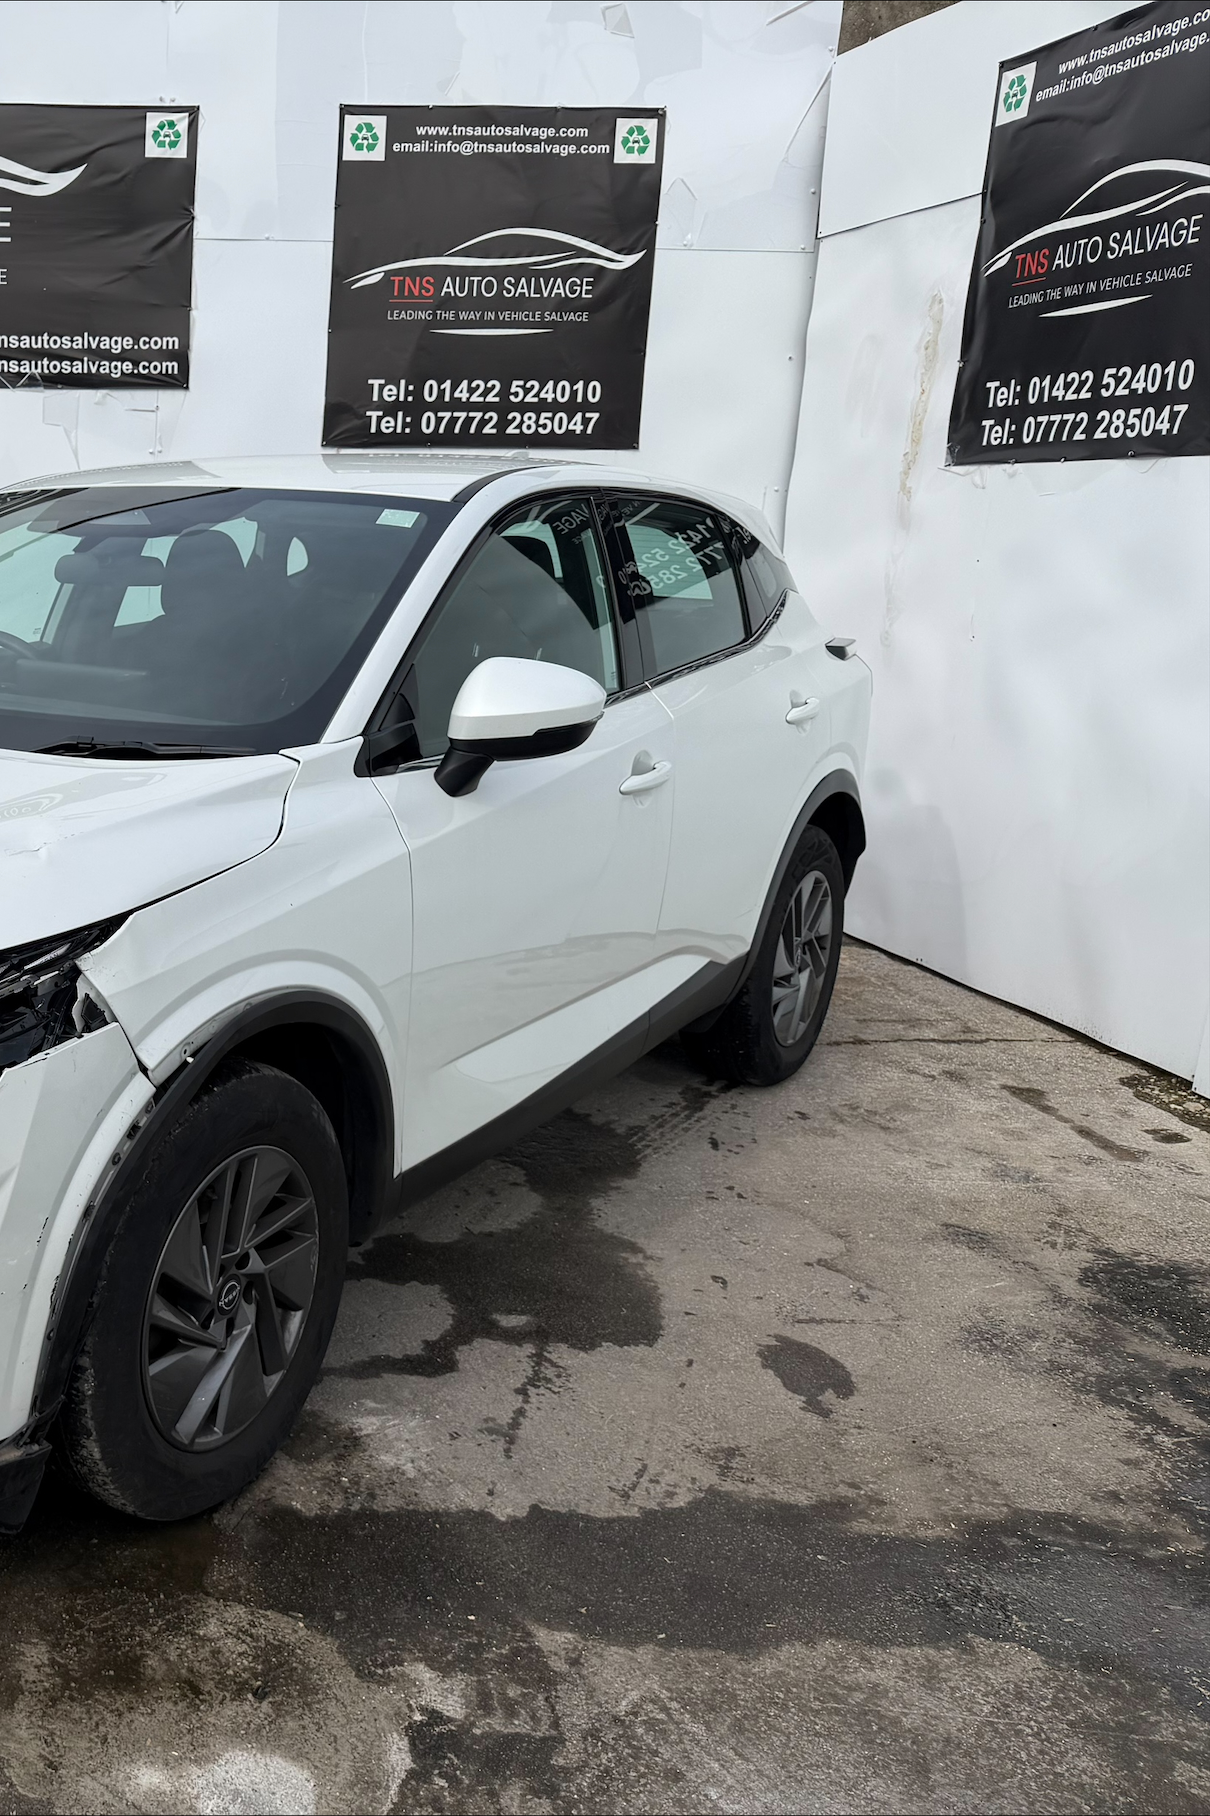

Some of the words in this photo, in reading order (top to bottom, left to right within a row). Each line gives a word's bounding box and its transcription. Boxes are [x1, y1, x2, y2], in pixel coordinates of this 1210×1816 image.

[416, 124, 588, 139] www.tnsautosalvage.com
[393, 141, 610, 156] email:info@tnsautosalvage.com
[1015, 249, 1050, 279] TNS
[1053, 234, 1103, 271] AUTO
[1107, 214, 1204, 260] SALVAGE
[390, 276, 435, 296] TNS
[441, 276, 497, 298] AUTO
[502, 276, 594, 298] SALVAGE
[1008, 291, 1044, 308] LEADING
[1045, 286, 1062, 302] THE
[1064, 281, 1085, 298] WAY
[1086, 280, 1097, 294] IN
[1099, 273, 1143, 293] VEHICLE
[1145, 263, 1193, 285] SALVAGE
[387, 310, 433, 320] LEADING
[435, 311, 455, 321] THE
[458, 311, 483, 321] WAY
[484, 311, 495, 321] IN
[498, 311, 541, 322] VEHICLE
[544, 311, 589, 322] SALVAGE
[368, 379, 413, 402] Tel:
[423, 380, 501, 403] 01422
[509, 381, 601, 403] 524010
[985, 379, 1021, 408] Tel:
[1027, 369, 1093, 404] 01422
[1101, 358, 1195, 397] 524010
[366, 411, 411, 434] Tel:
[421, 412, 498, 434] 07772
[505, 412, 600, 435] 285047
[981, 418, 1017, 446] Tel:
[1023, 410, 1087, 443] 07772
[1093, 403, 1189, 440] 285047
